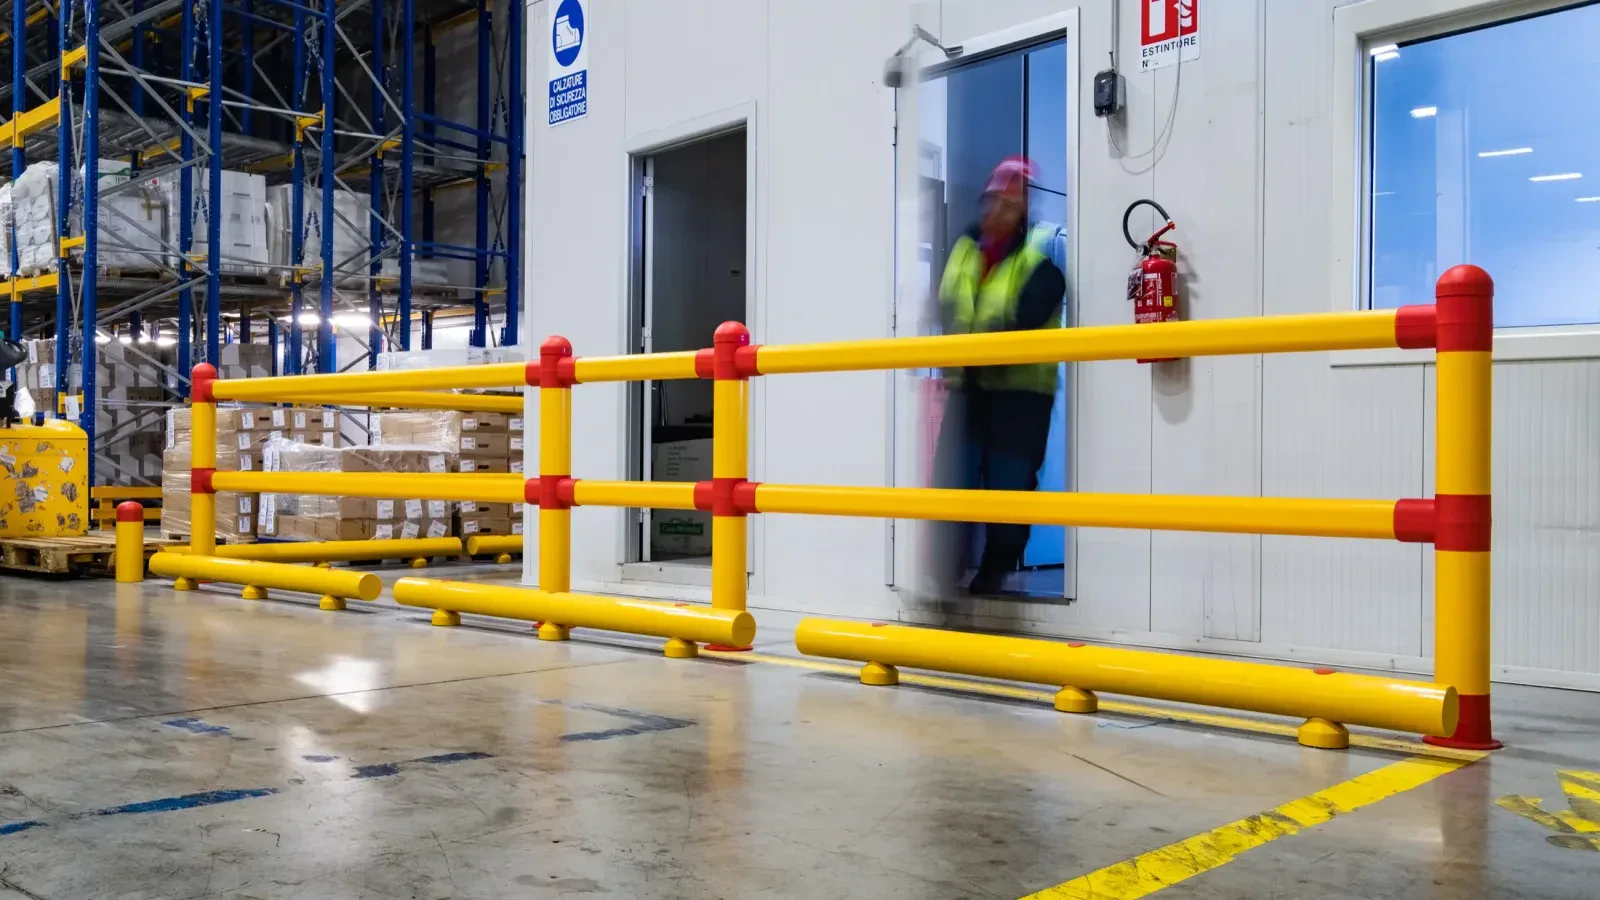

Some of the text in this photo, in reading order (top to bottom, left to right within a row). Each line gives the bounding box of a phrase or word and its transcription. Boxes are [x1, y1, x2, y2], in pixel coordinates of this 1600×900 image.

[1142, 36, 1196, 57] ESTINTORE
[553, 73, 583, 93] CALZATURE
[550, 87, 586, 108] DI SICUREZZA
[549, 101, 586, 122] OBBLIGATORIE
